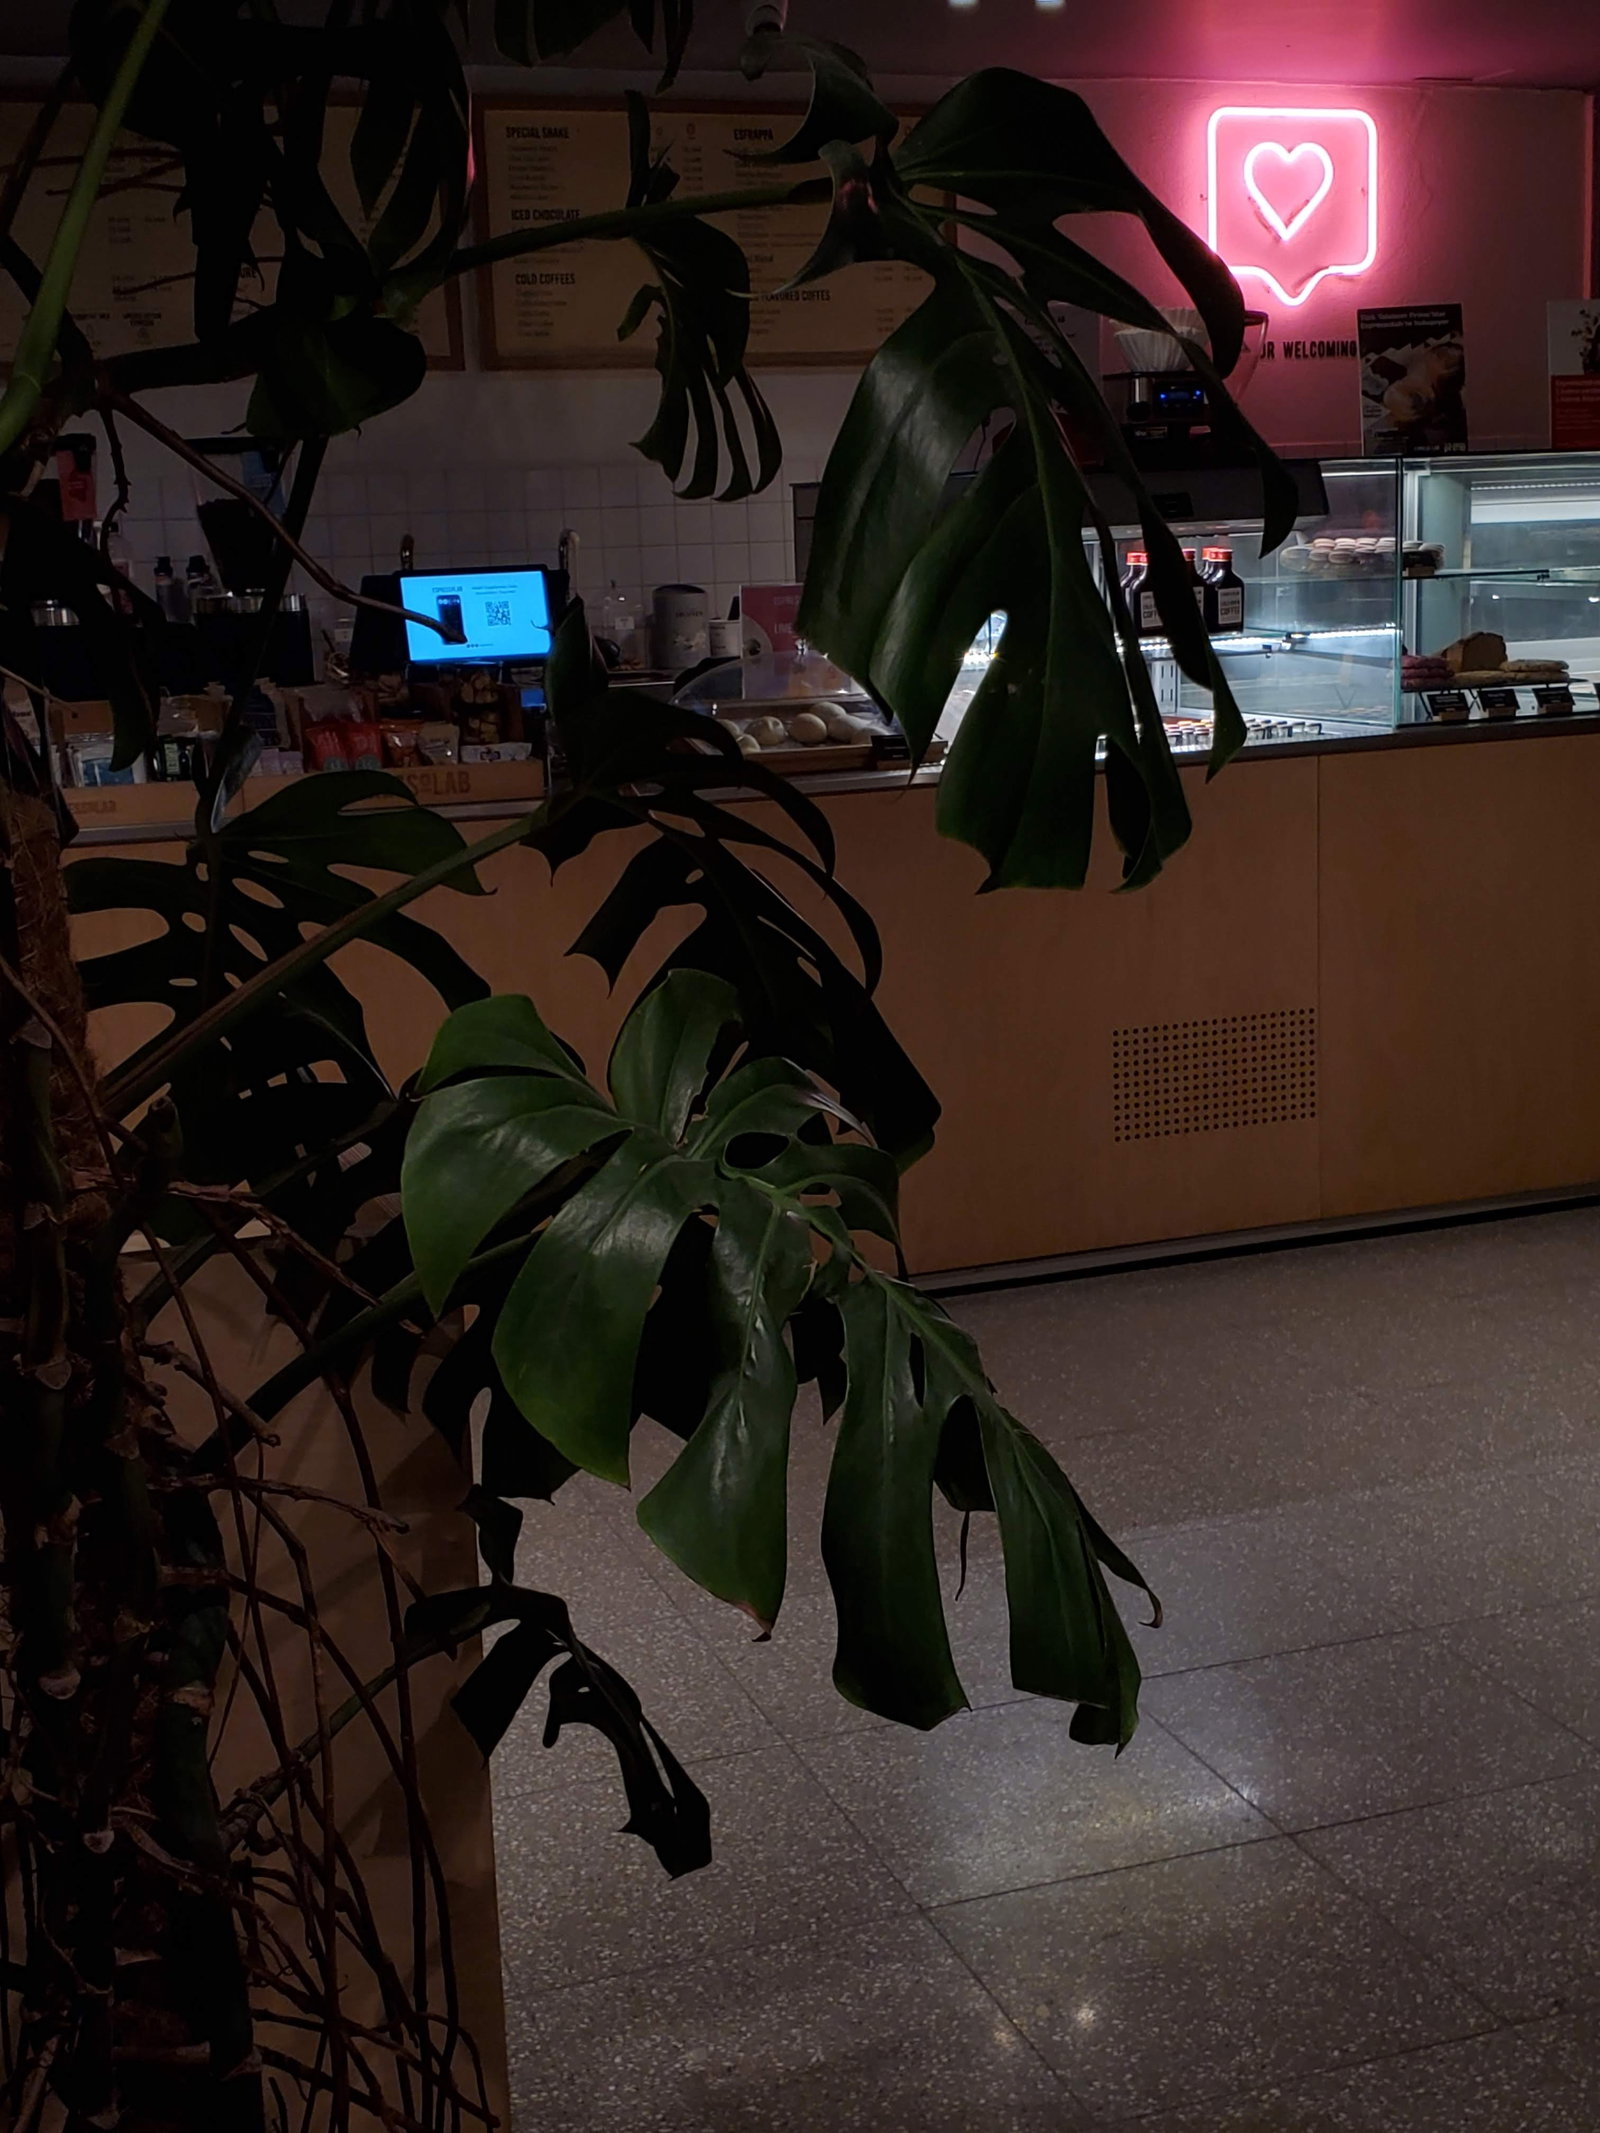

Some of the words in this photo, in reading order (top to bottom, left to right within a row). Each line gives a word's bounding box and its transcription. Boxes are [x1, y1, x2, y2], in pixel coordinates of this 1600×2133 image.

[511, 209, 531, 221] ICED
[515, 273, 537, 286] COLD
[1283, 339, 1357, 358] WELCOMING
